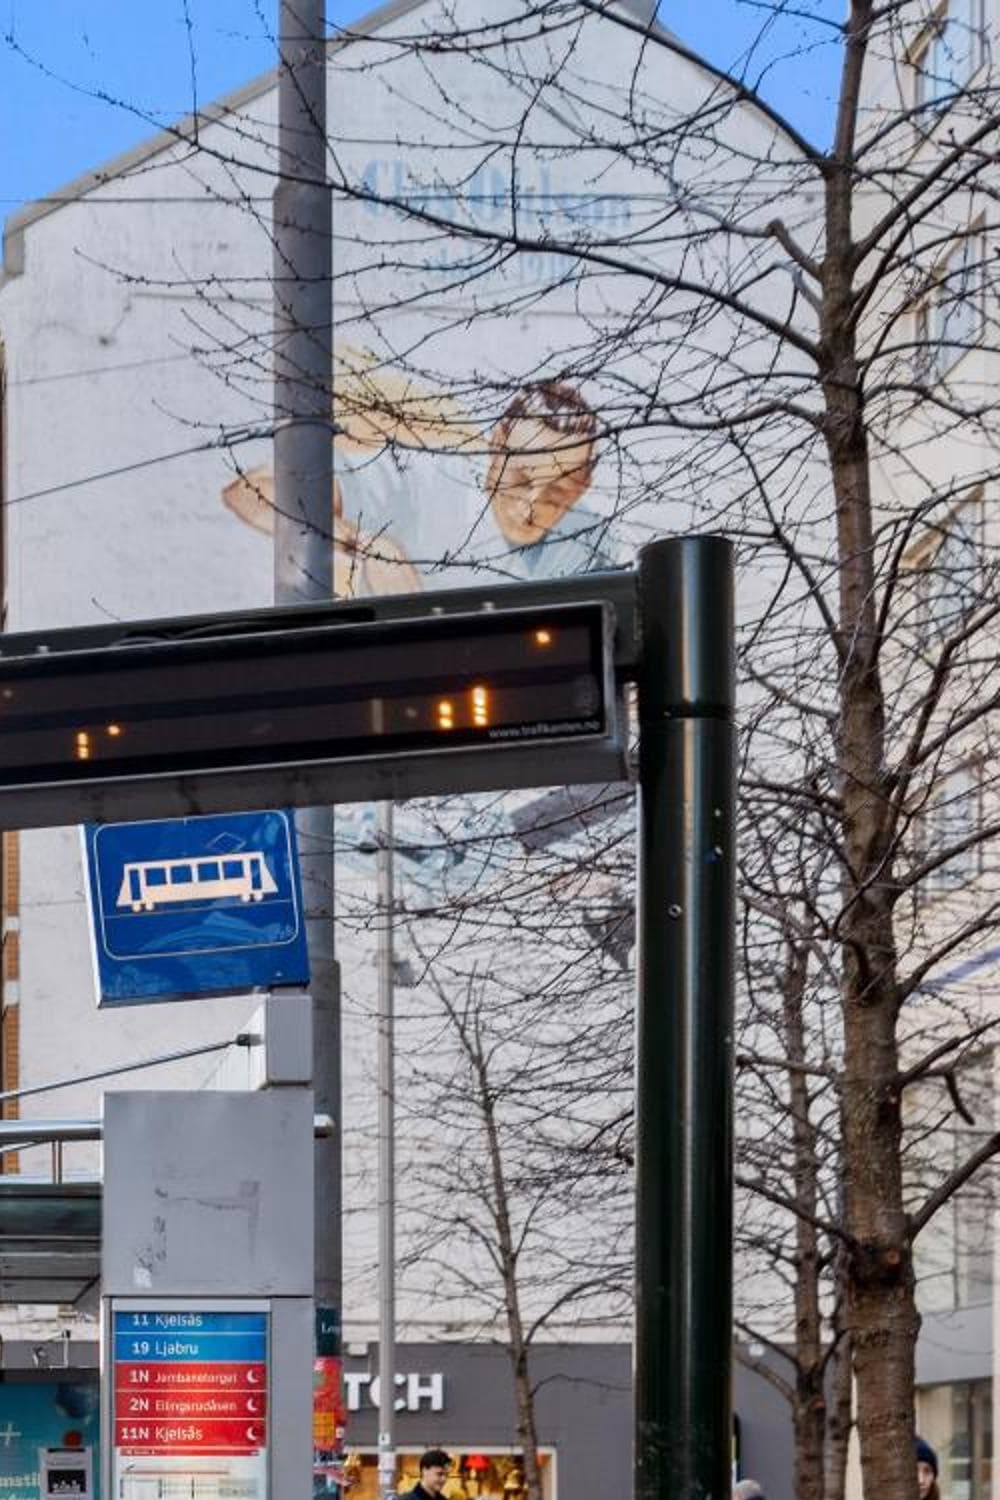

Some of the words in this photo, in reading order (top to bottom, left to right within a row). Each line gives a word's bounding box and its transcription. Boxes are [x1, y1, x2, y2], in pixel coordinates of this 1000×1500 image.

[132, 1314, 149, 1326] 11
[155, 1313, 203, 1328] Kjelsås
[132, 1341, 149, 1355] 19
[155, 1341, 199, 1357] Ljabru
[129, 1370, 149, 1383] 1N
[344, 1373, 443, 1411] TCH
[129, 1397, 149, 1411] 2N
[121, 1427, 149, 1440] 11N
[155, 1426, 203, 1442] Kjelsås
